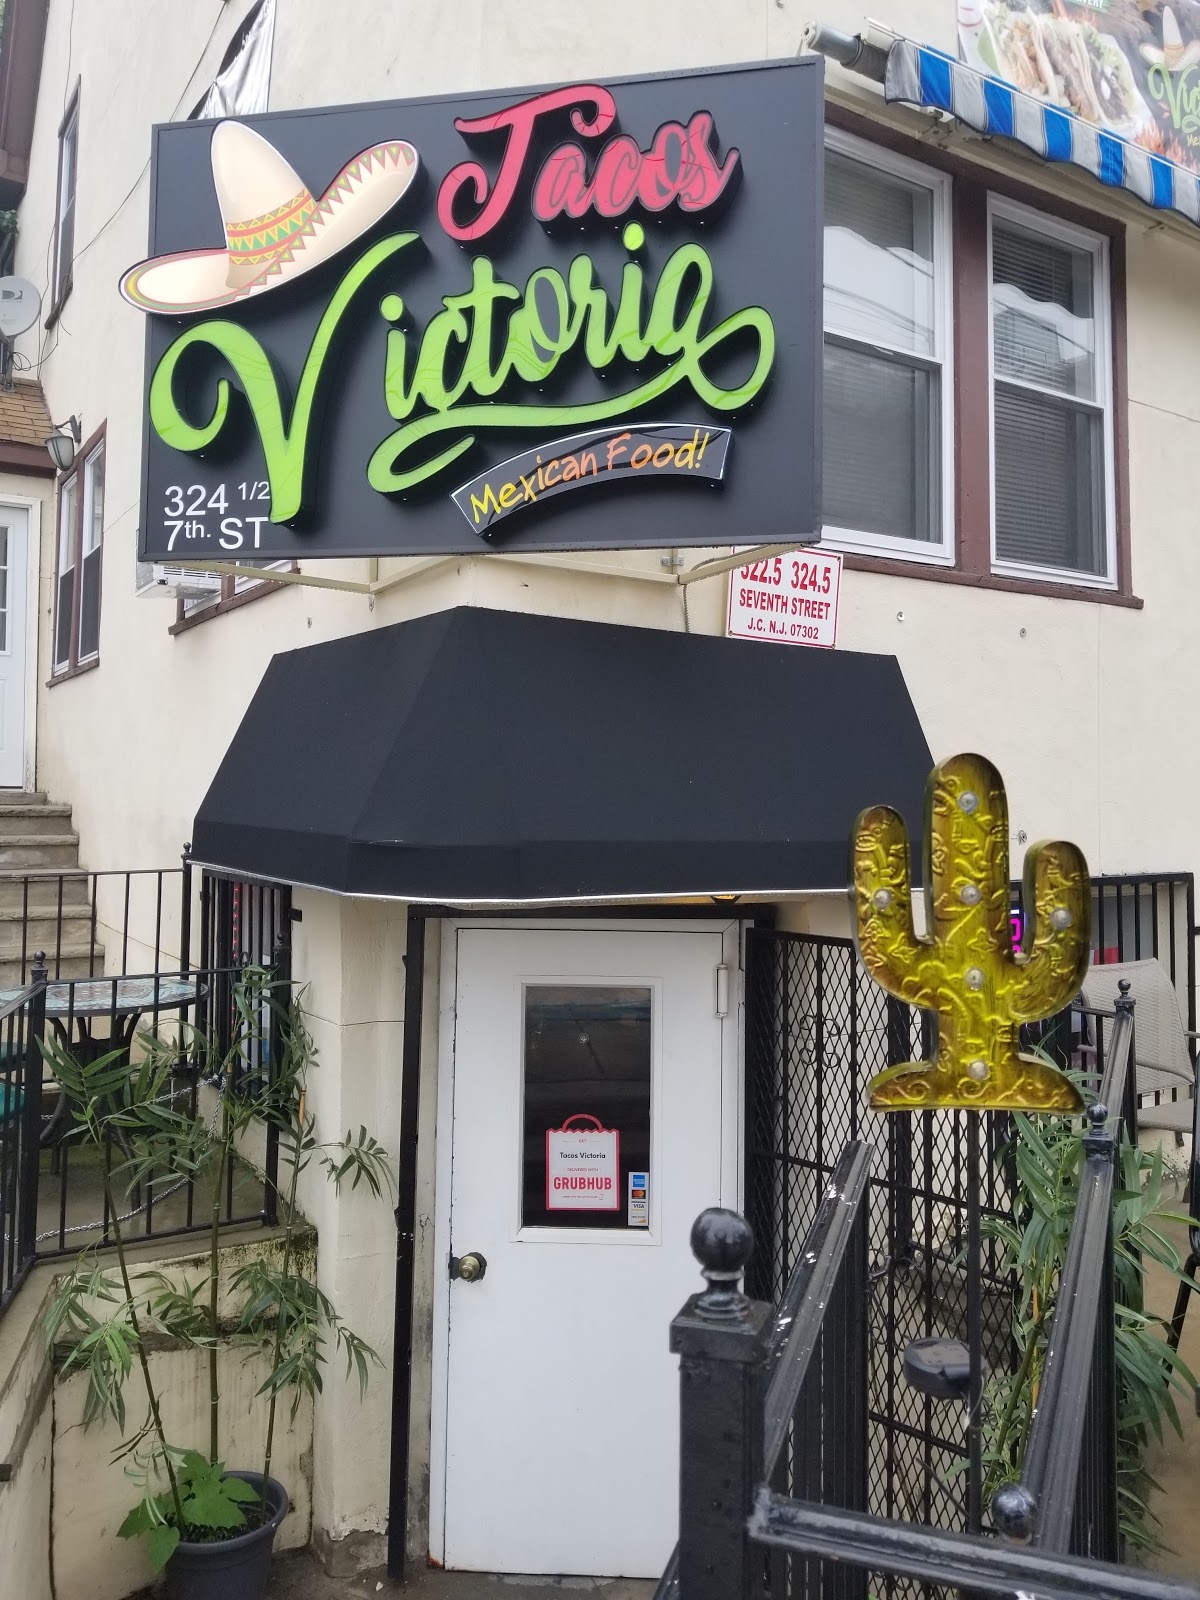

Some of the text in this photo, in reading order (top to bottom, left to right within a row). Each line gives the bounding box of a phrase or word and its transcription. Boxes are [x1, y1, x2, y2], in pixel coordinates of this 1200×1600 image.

[437, 85, 738, 242] Tacos
[149, 223, 776, 522] Victoria
[470, 430, 710, 524] Mexican Food!
[164, 481, 270, 517] 324 1/2
[163, 517, 269, 551] 7th. ST
[791, 560, 832, 595] 324.5
[739, 588, 831, 620] SEVENTH STREET
[747, 617, 819, 640] J.C. N.J. 07302
[553, 1176, 612, 1190] GRUBHUB
